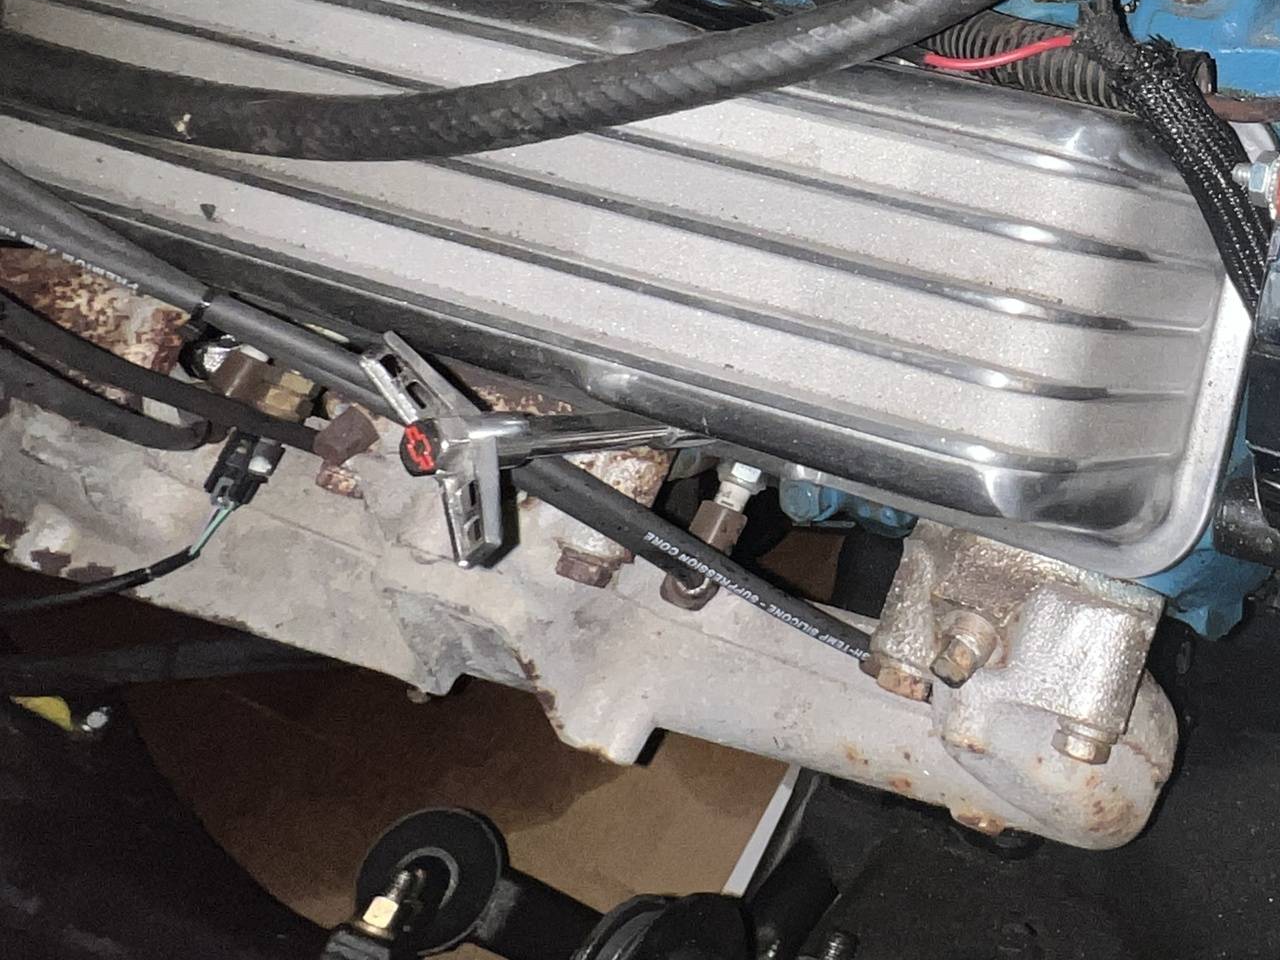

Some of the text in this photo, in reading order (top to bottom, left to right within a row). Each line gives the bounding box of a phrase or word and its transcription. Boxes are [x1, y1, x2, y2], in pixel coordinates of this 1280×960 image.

[642, 531, 680, 557] CORE
[678, 552, 759, 604] SUPPRESSION
[766, 603, 820, 637] SILICONE
